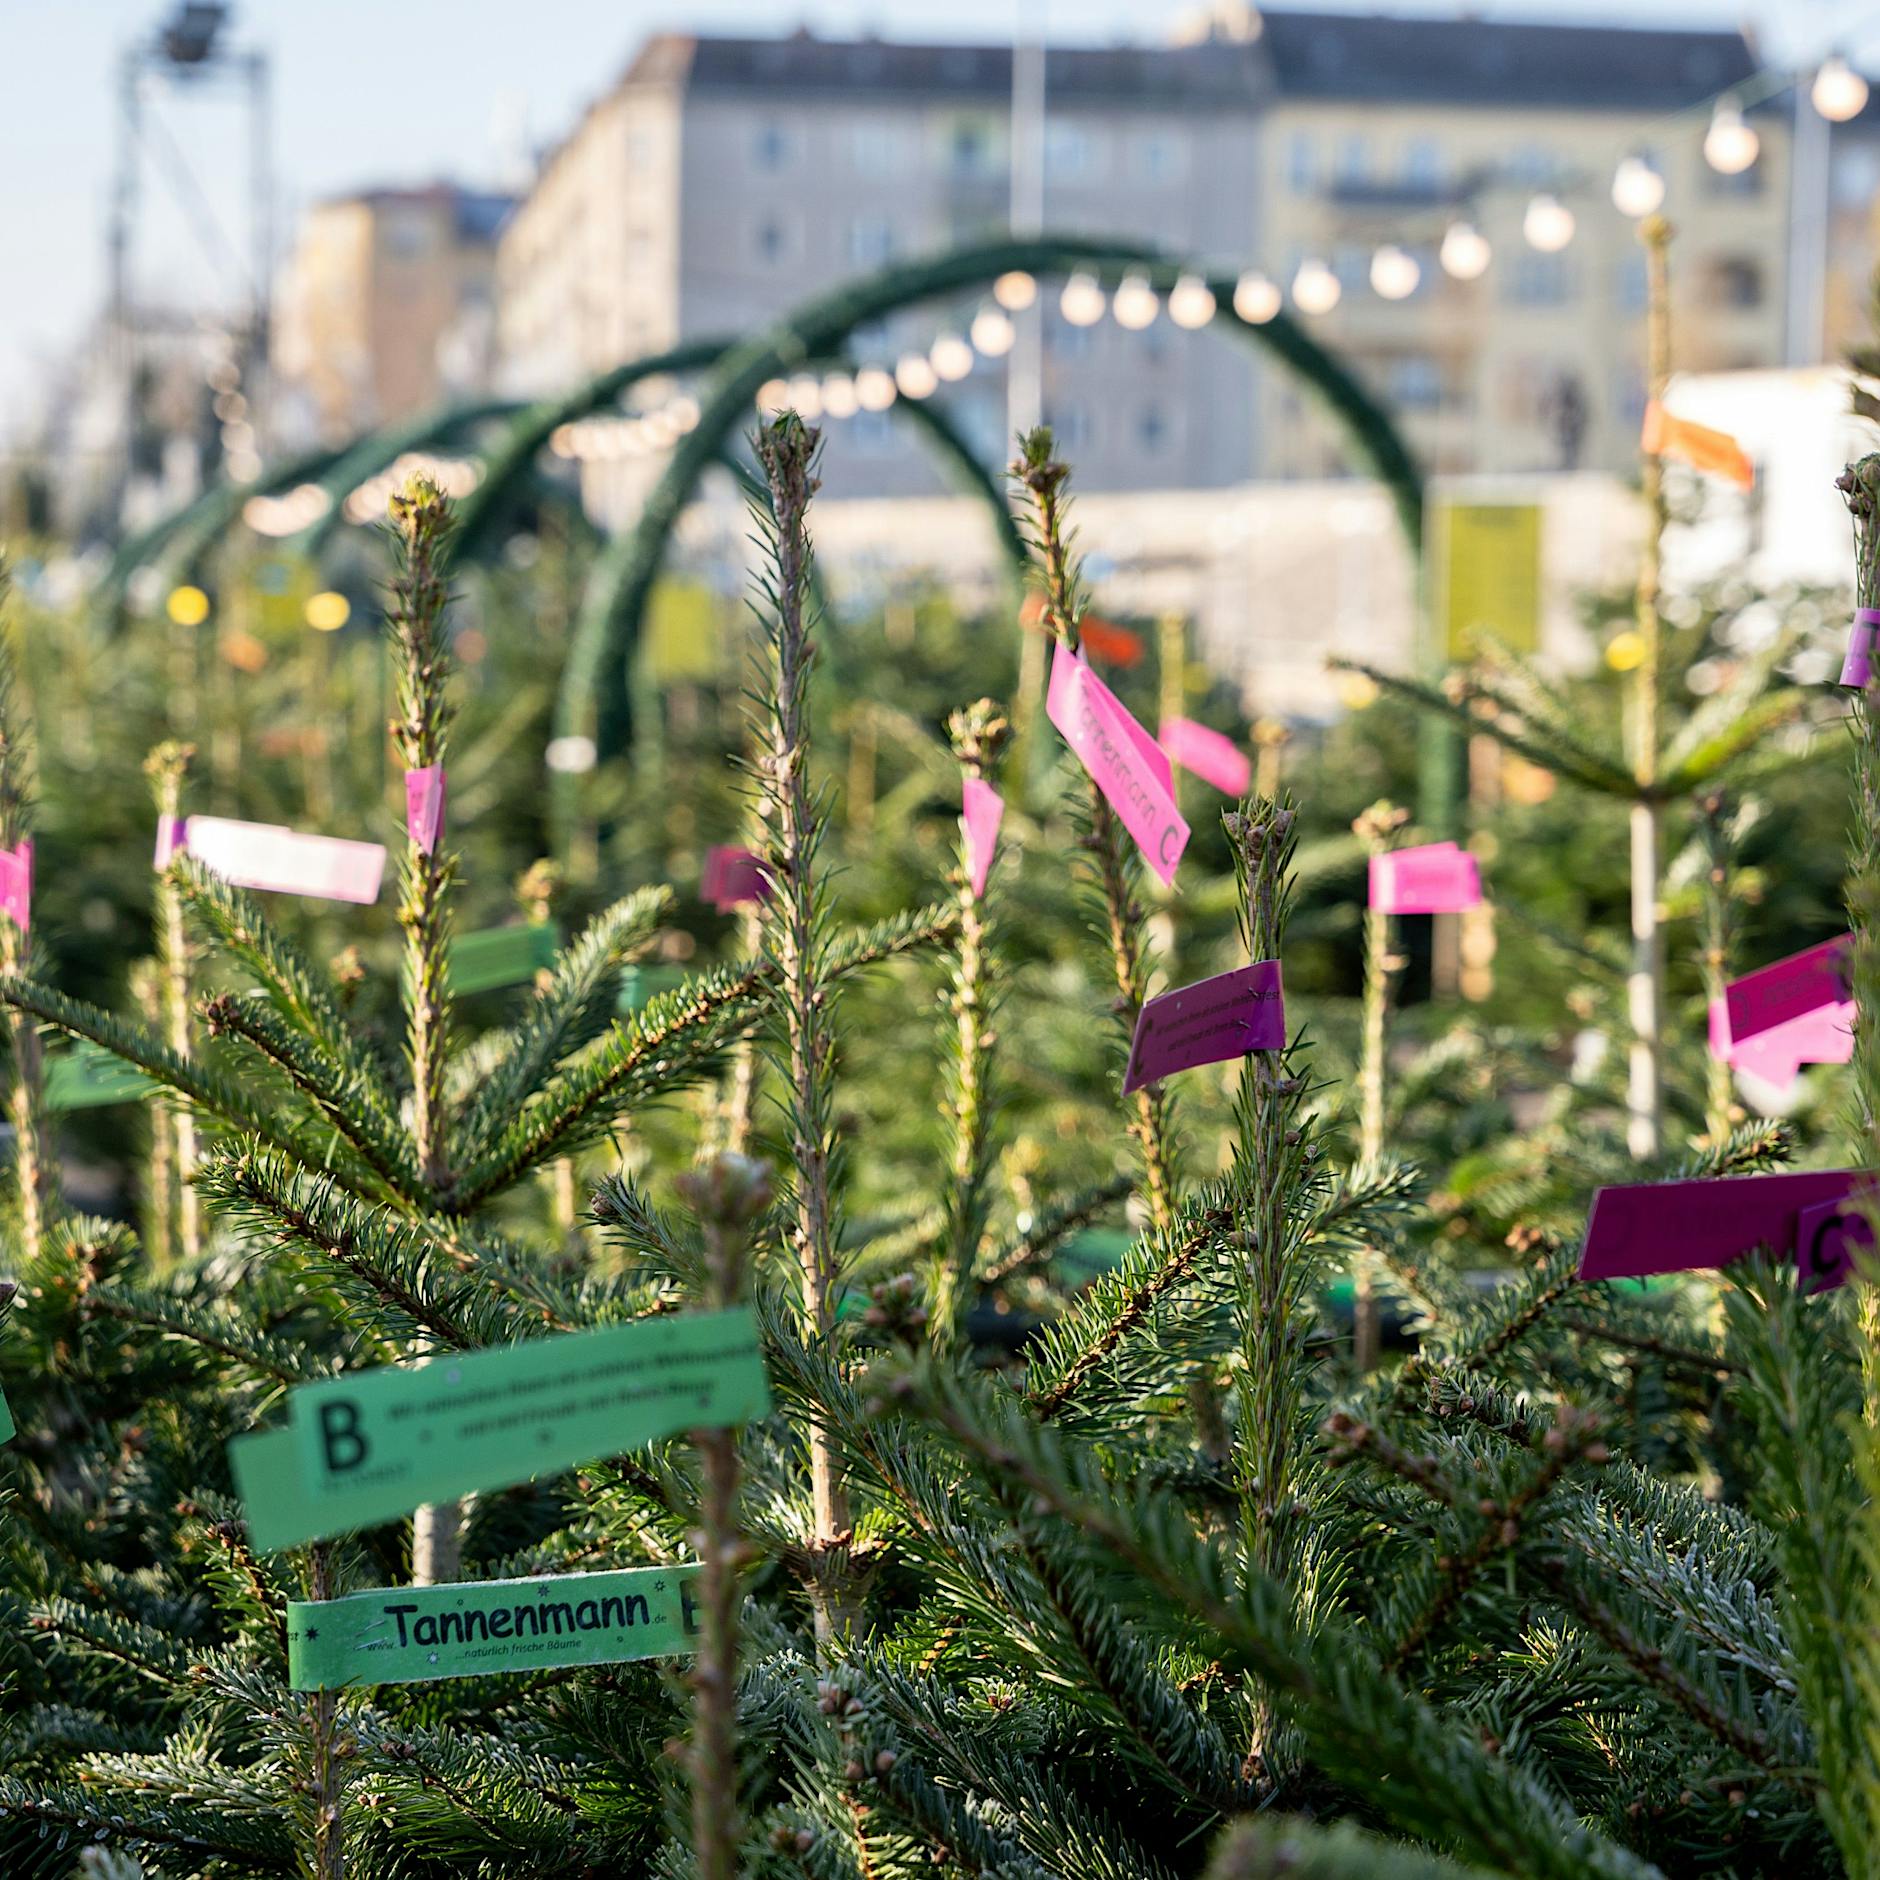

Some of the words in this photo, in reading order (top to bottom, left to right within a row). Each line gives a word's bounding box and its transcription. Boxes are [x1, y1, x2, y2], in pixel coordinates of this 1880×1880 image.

[1159, 824, 1179, 867] C
[1811, 1215, 1844, 1274] C
[320, 1398, 370, 1472] B
[511, 1641, 545, 1657] frische
[547, 1639, 582, 1651] Bäume
